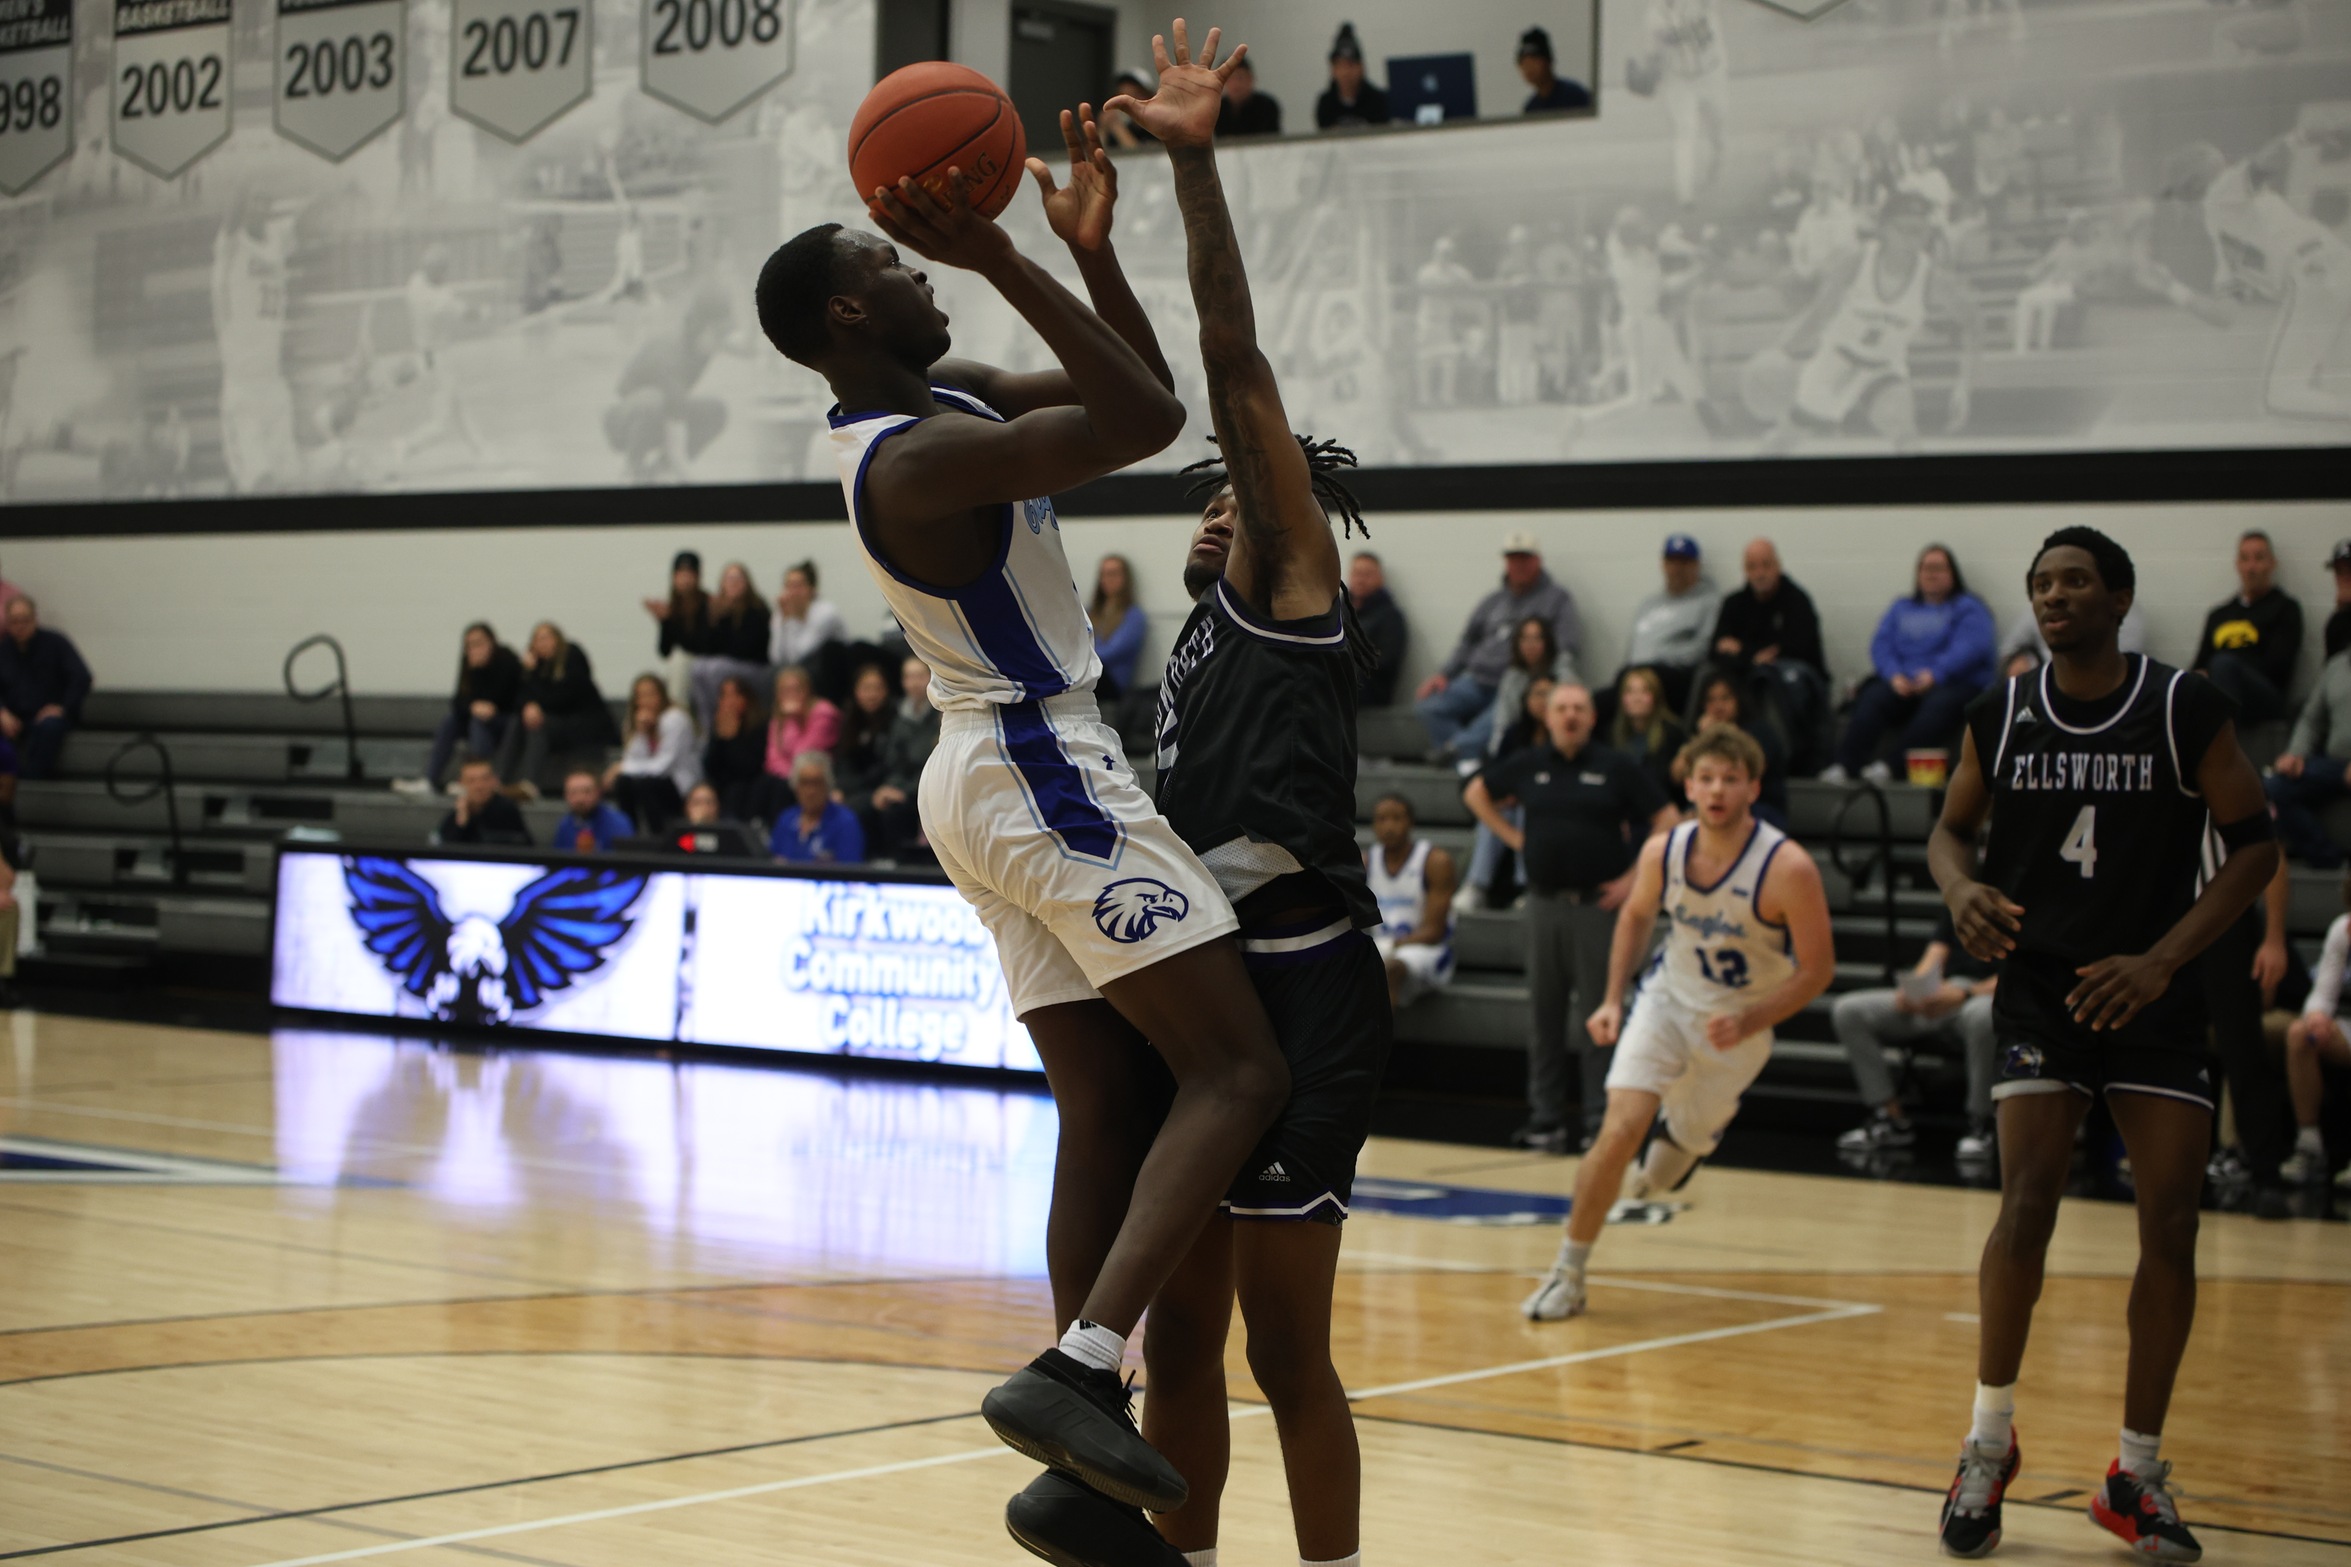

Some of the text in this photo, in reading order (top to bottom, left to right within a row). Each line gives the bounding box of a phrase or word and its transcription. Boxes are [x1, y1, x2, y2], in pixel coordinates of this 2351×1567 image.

[462, 9, 580, 77] 2007
[654, 0, 780, 54] 2008
[120, 54, 222, 119] 2002
[285, 33, 394, 98] 2003
[2011, 752, 2154, 791] ELLSWORTH
[2059, 805, 2098, 878] 4
[783, 934, 1000, 1011] Community
[1695, 946, 1752, 988] 12
[821, 994, 967, 1062] College
[1259, 1174, 1291, 1182] adidas
